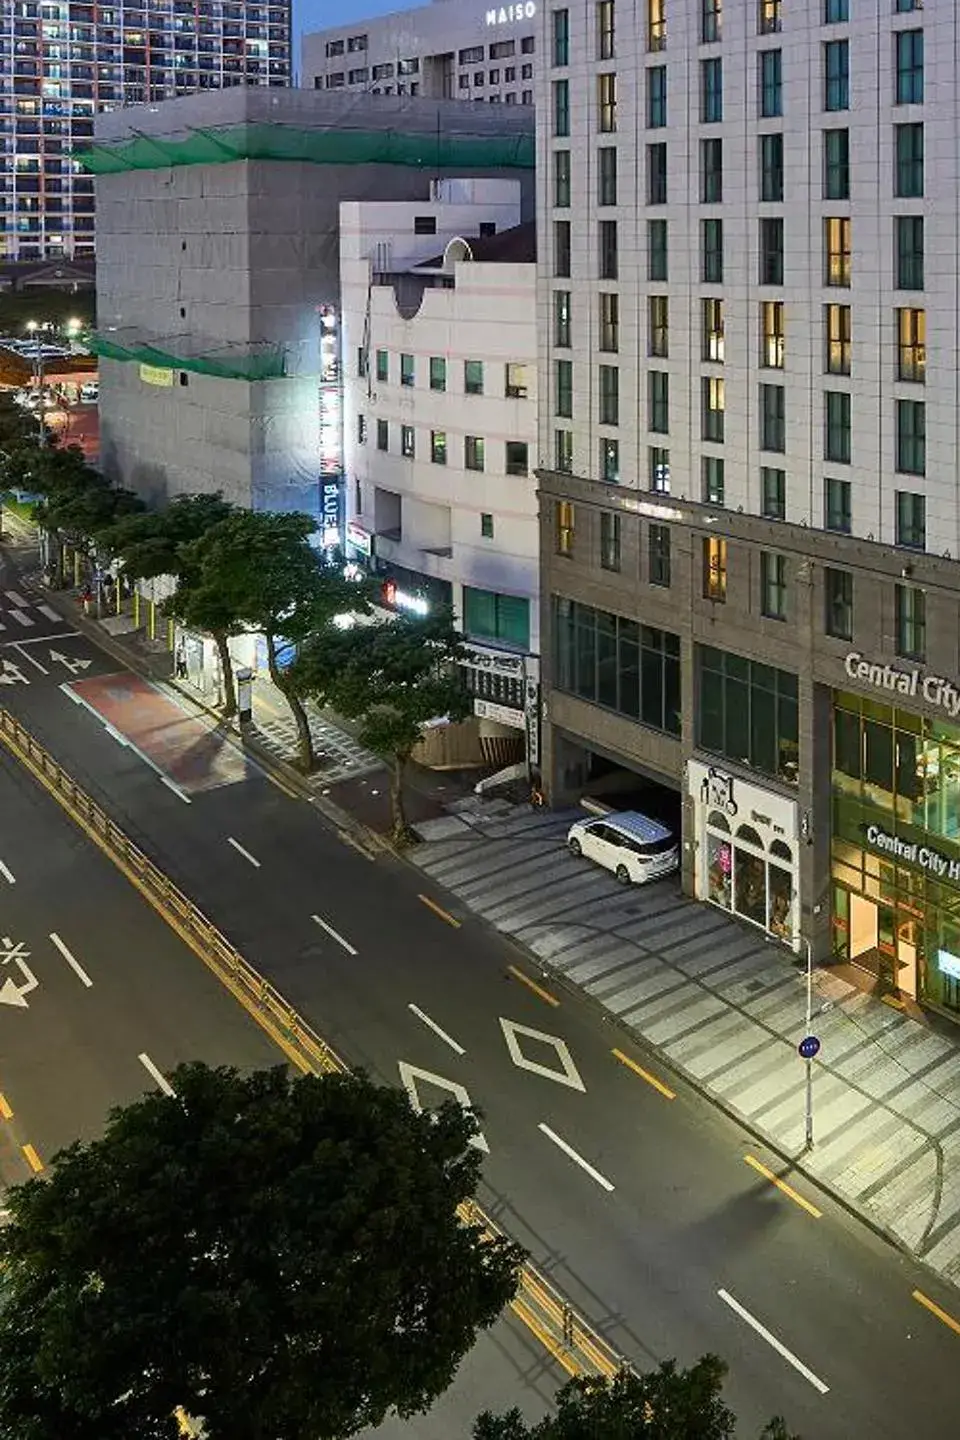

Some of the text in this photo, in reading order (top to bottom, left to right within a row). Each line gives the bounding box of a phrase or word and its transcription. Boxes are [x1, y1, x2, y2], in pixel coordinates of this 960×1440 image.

[844, 652, 918, 696] Central
[866, 826, 917, 862] Central
[919, 847, 948, 876] City
